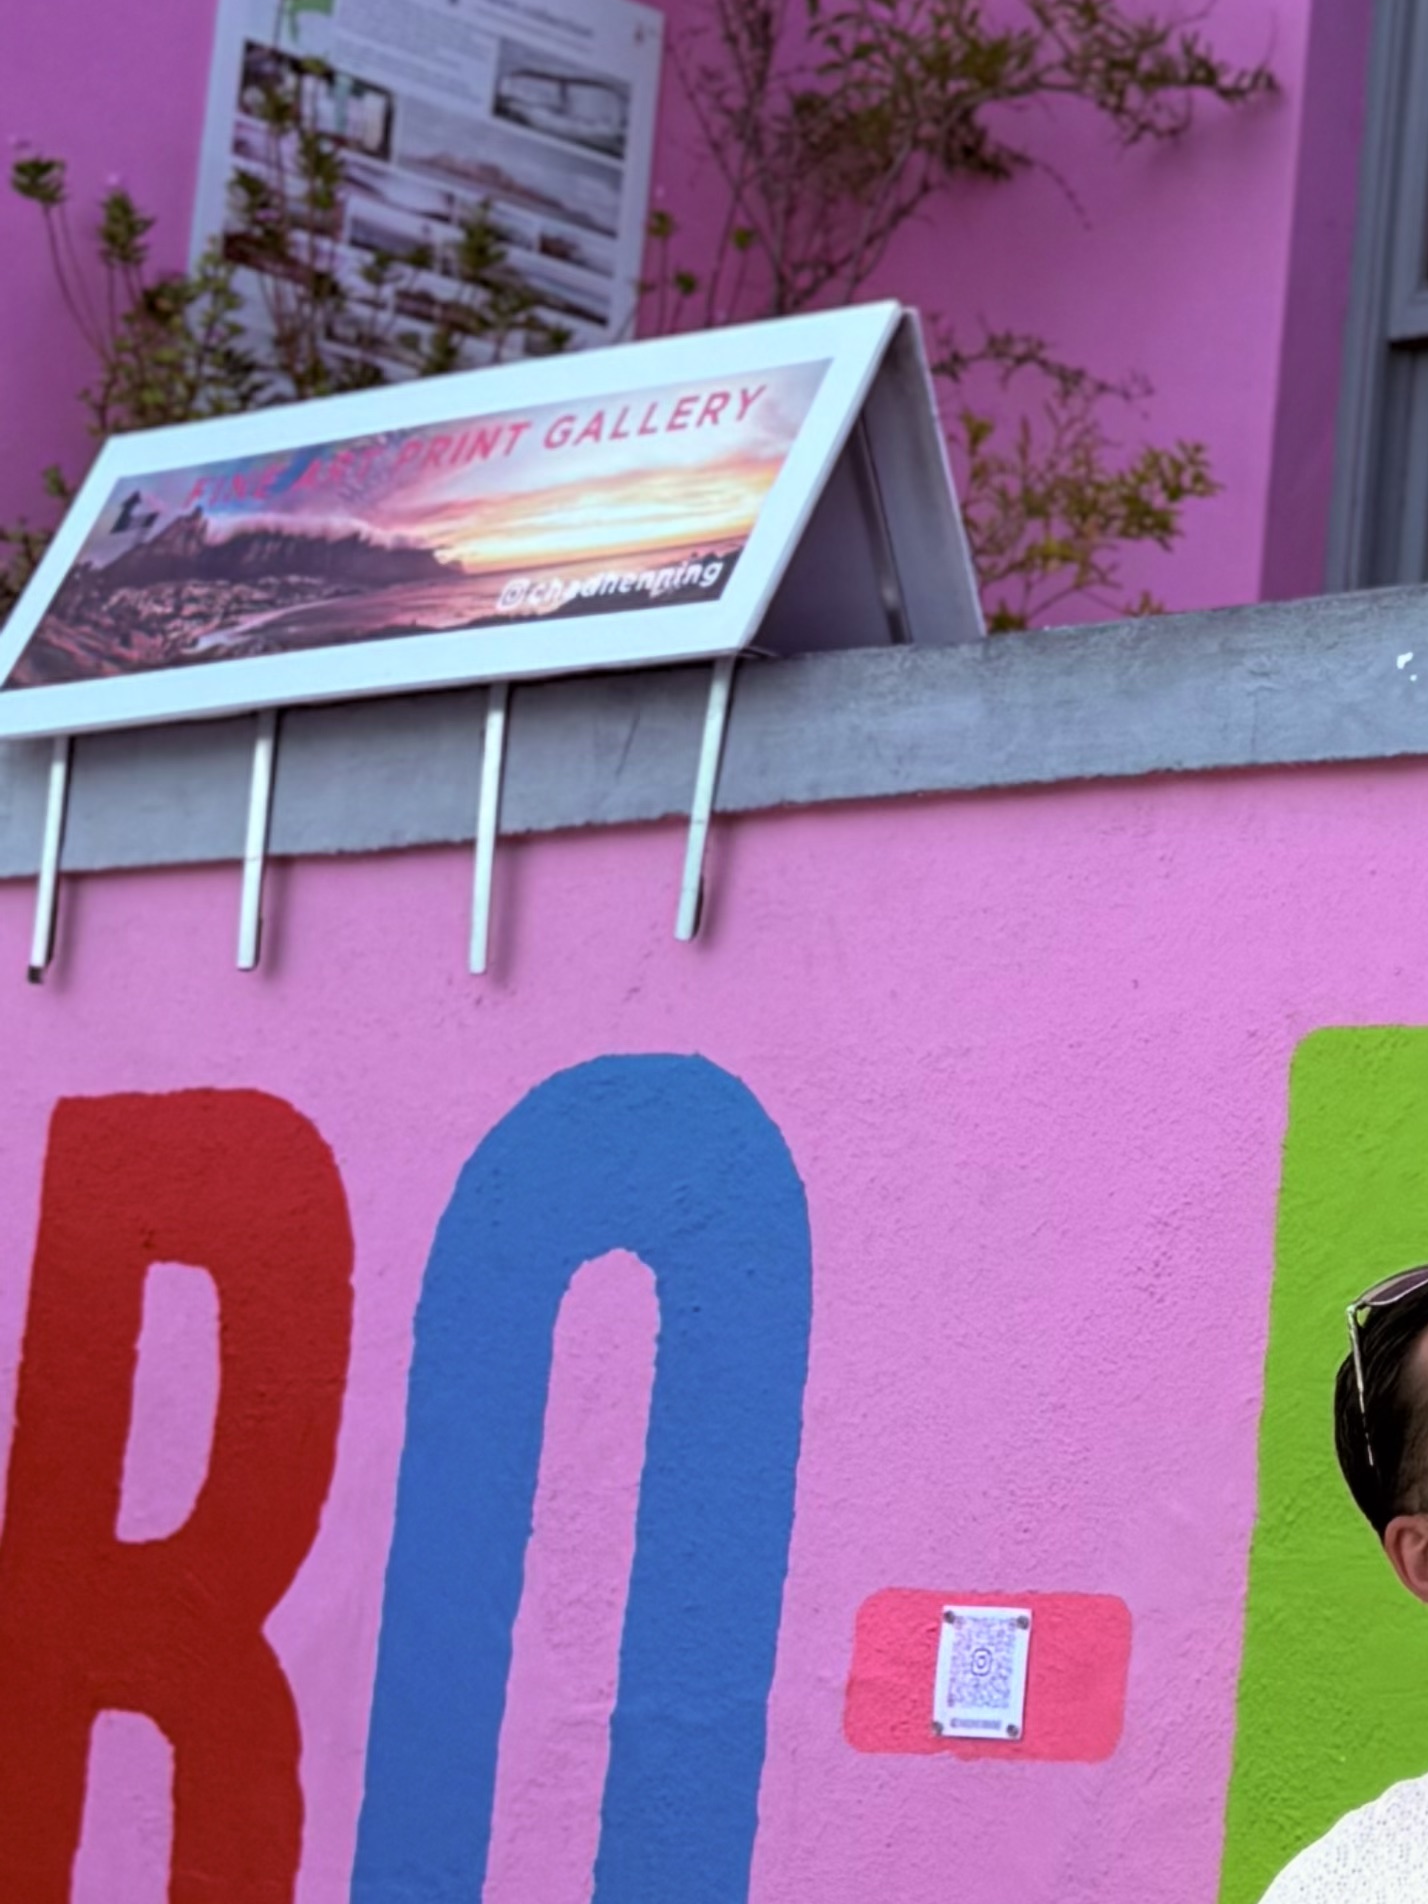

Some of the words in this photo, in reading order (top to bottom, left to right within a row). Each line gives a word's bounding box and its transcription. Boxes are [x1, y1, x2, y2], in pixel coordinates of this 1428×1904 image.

[184, 462, 288, 509] FINE
[290, 447, 384, 494] ART
[394, 421, 531, 473] PRINT
[542, 384, 768, 451] GALLERY
